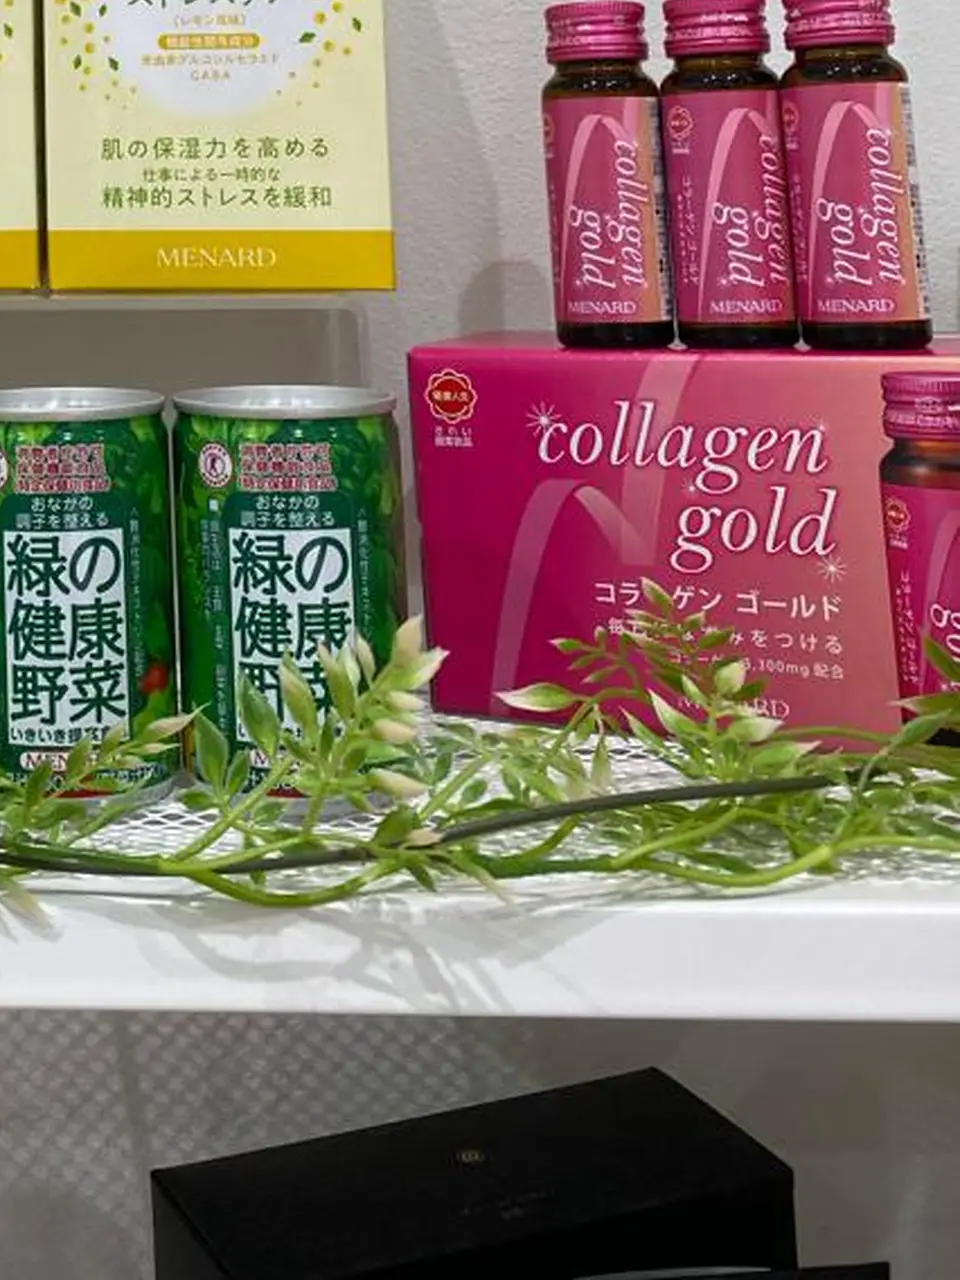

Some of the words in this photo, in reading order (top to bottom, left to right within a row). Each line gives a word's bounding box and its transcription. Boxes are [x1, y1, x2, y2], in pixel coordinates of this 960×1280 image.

[101, 137, 329, 160] 肌の保湿力を高める
[143, 167, 280, 183] 仕事による一時的な
[103, 186, 332, 209] 精神的ストレスを緩和
[607, 137, 649, 287] collagen
[754, 133, 790, 282] collagen
[861, 125, 907, 284] collagen
[156, 247, 277, 268] MENARD
[568, 206, 616, 289] gold
[712, 202, 765, 287] gold
[815, 198, 873, 287] gold
[568, 300, 636, 314] MENARD
[710, 299, 782, 314] MENARD
[818, 298, 894, 314] MENARD
[538, 400, 828, 495] collagen
[31, 496, 93, 512] おなかの
[255, 495, 319, 510] おなかの
[669, 486, 837, 573] gold
[7, 534, 122, 597] 緑の
[233, 532, 349, 594] 緑の
[8, 597, 124, 661] 健康
[234, 597, 352, 660] 健康
[595, 582, 722, 611] コラゲン
[737, 590, 842, 621] ゴールド
[11, 660, 126, 725] 野菜
